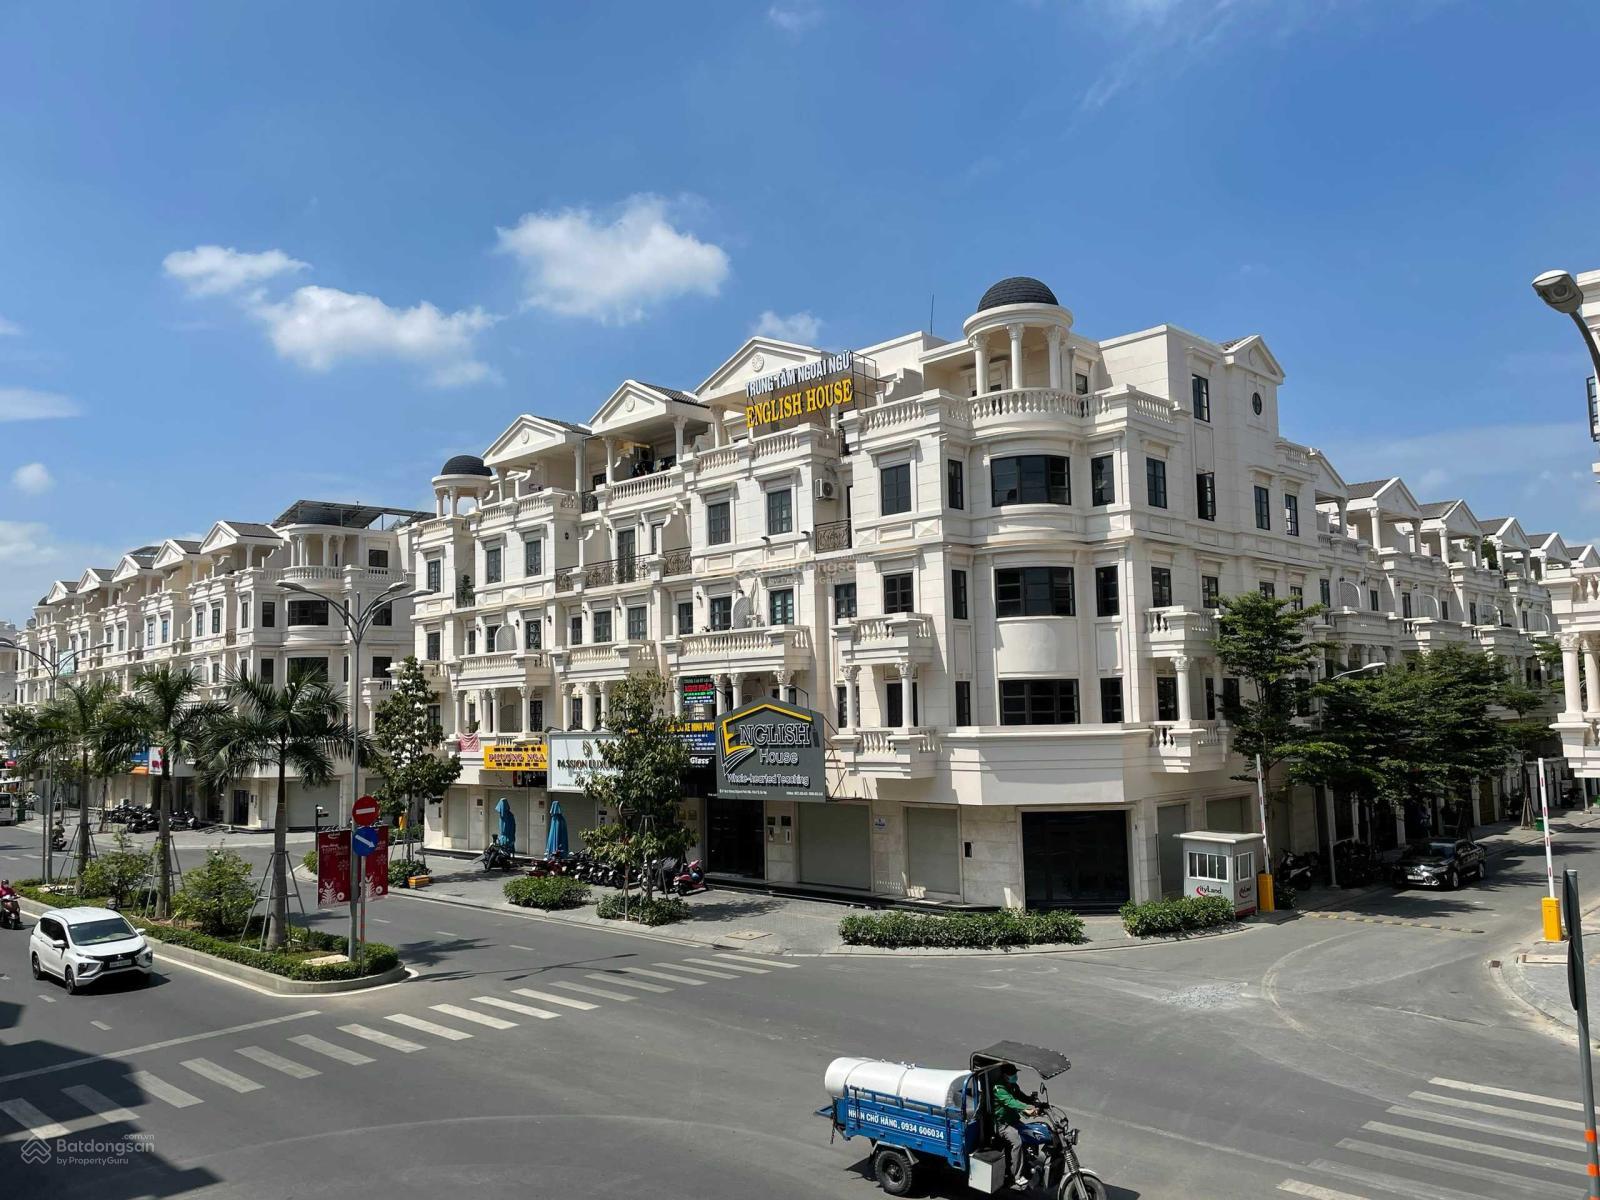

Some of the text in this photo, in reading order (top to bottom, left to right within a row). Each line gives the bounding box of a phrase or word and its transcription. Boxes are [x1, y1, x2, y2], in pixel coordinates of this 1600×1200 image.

[745, 376, 774, 398] TRUNG
[774, 368, 796, 389] TÂM
[796, 360, 826, 380] NGOẠI
[745, 378, 853, 428] ENGLISH HOUSE
[557, 759, 588, 769] PASSION
[689, 756, 710, 765] Glass
[776, 773, 810, 787] Teaching
